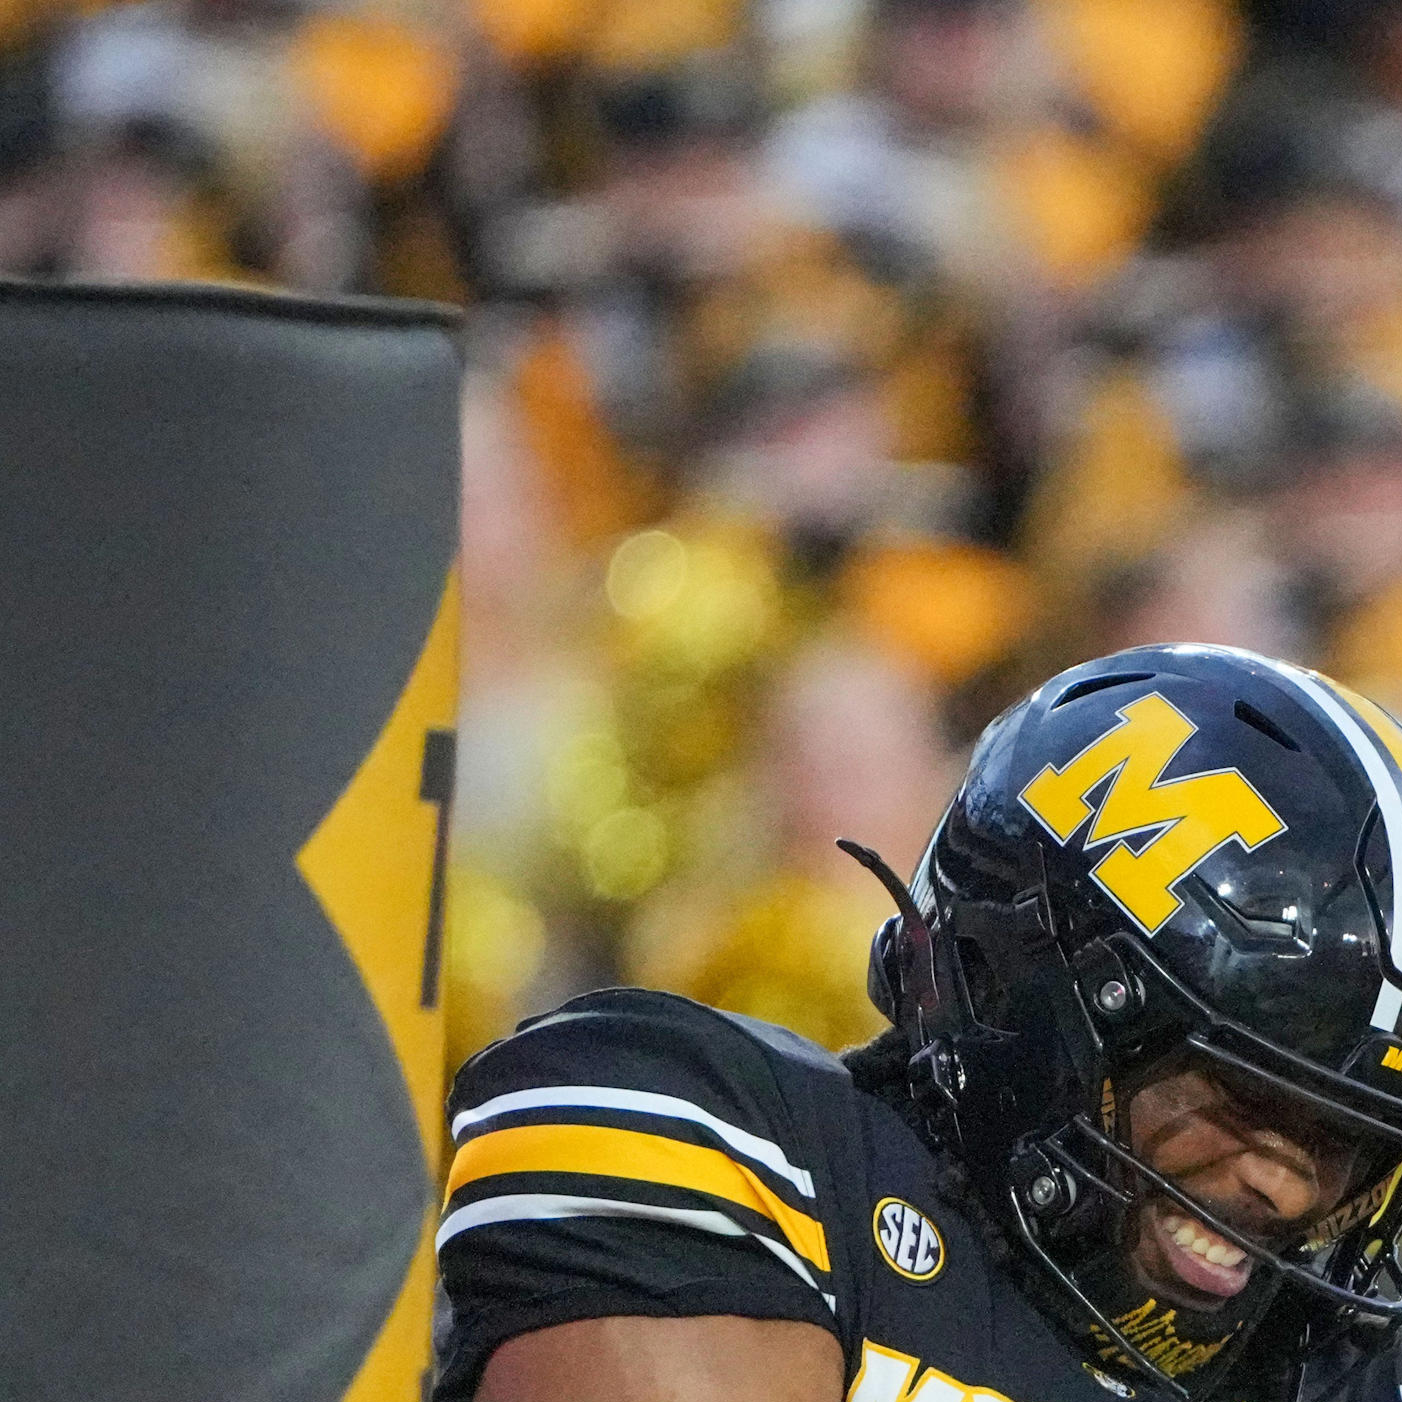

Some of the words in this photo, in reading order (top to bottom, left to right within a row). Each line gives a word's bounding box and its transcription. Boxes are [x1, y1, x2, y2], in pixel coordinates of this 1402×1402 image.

[1017, 692, 1288, 938] M
[878, 1204, 941, 1275] SEC
[1303, 1174, 1394, 1249] MIZZO
